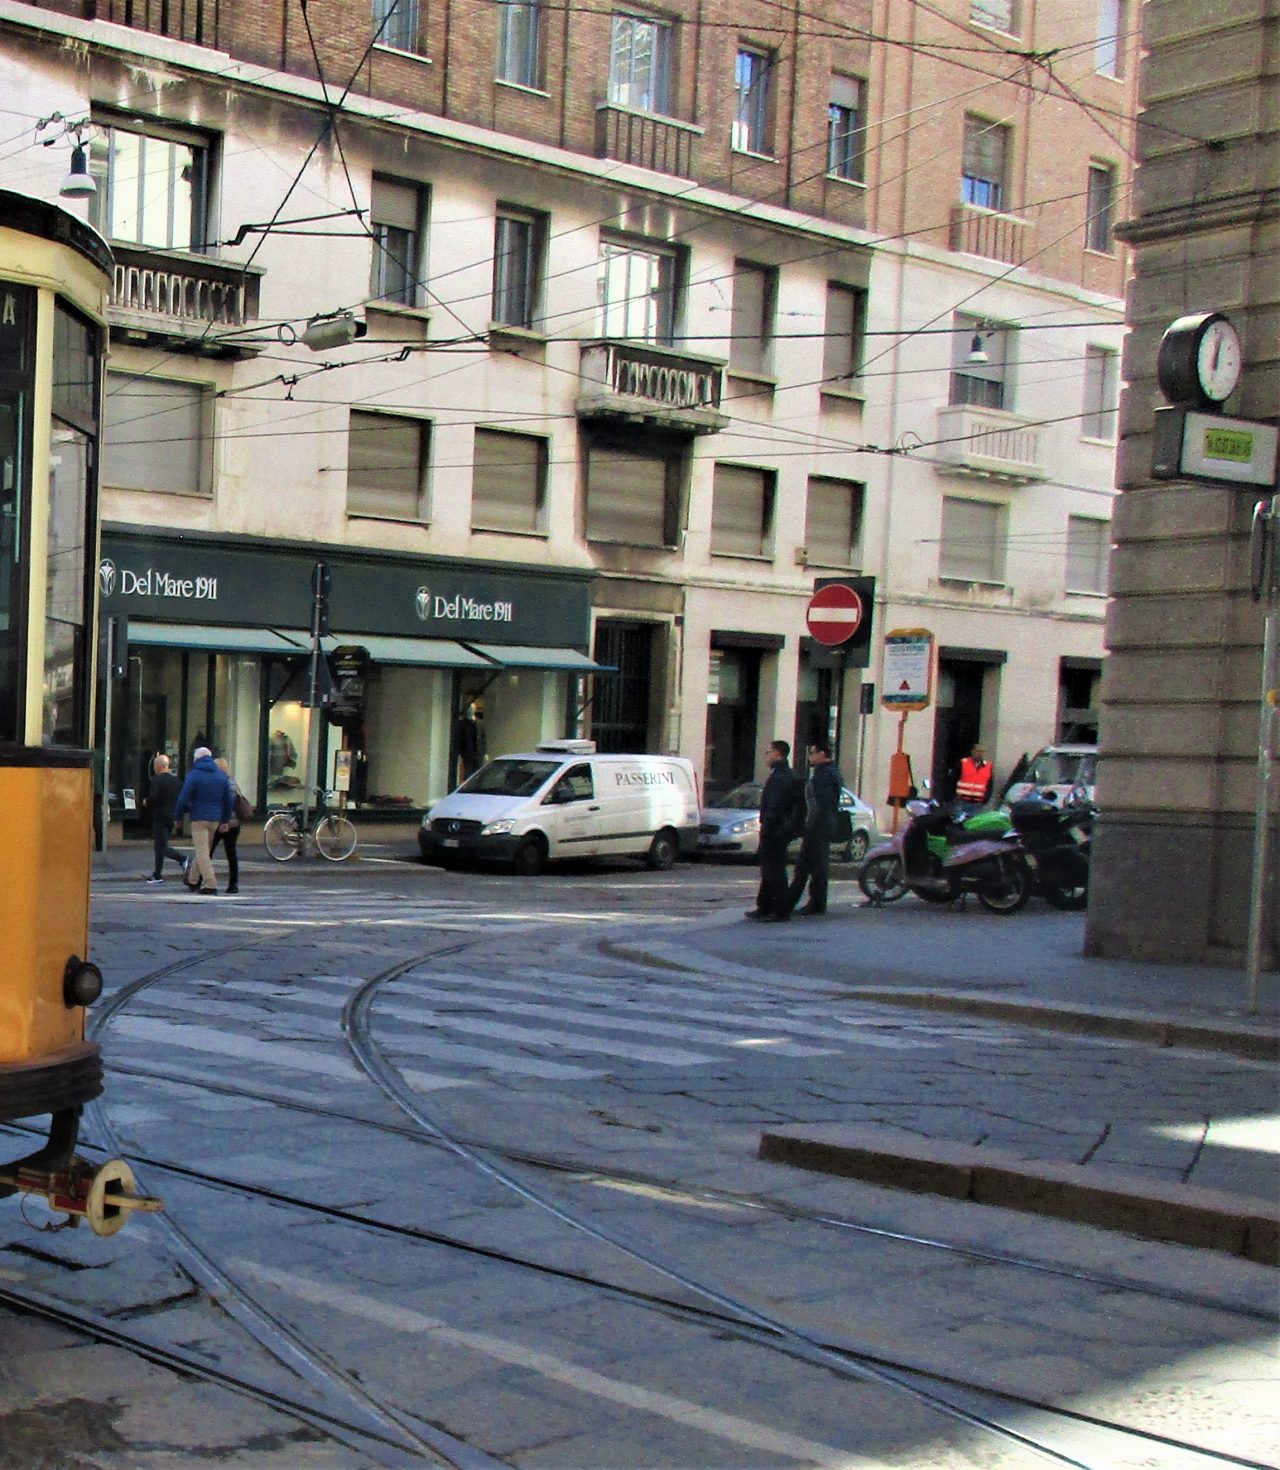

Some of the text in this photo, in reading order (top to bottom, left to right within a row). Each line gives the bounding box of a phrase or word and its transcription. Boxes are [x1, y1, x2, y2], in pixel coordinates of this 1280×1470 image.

[121, 568, 217, 600] Del Mare 1911
[434, 594, 512, 621] Del Mare 1911
